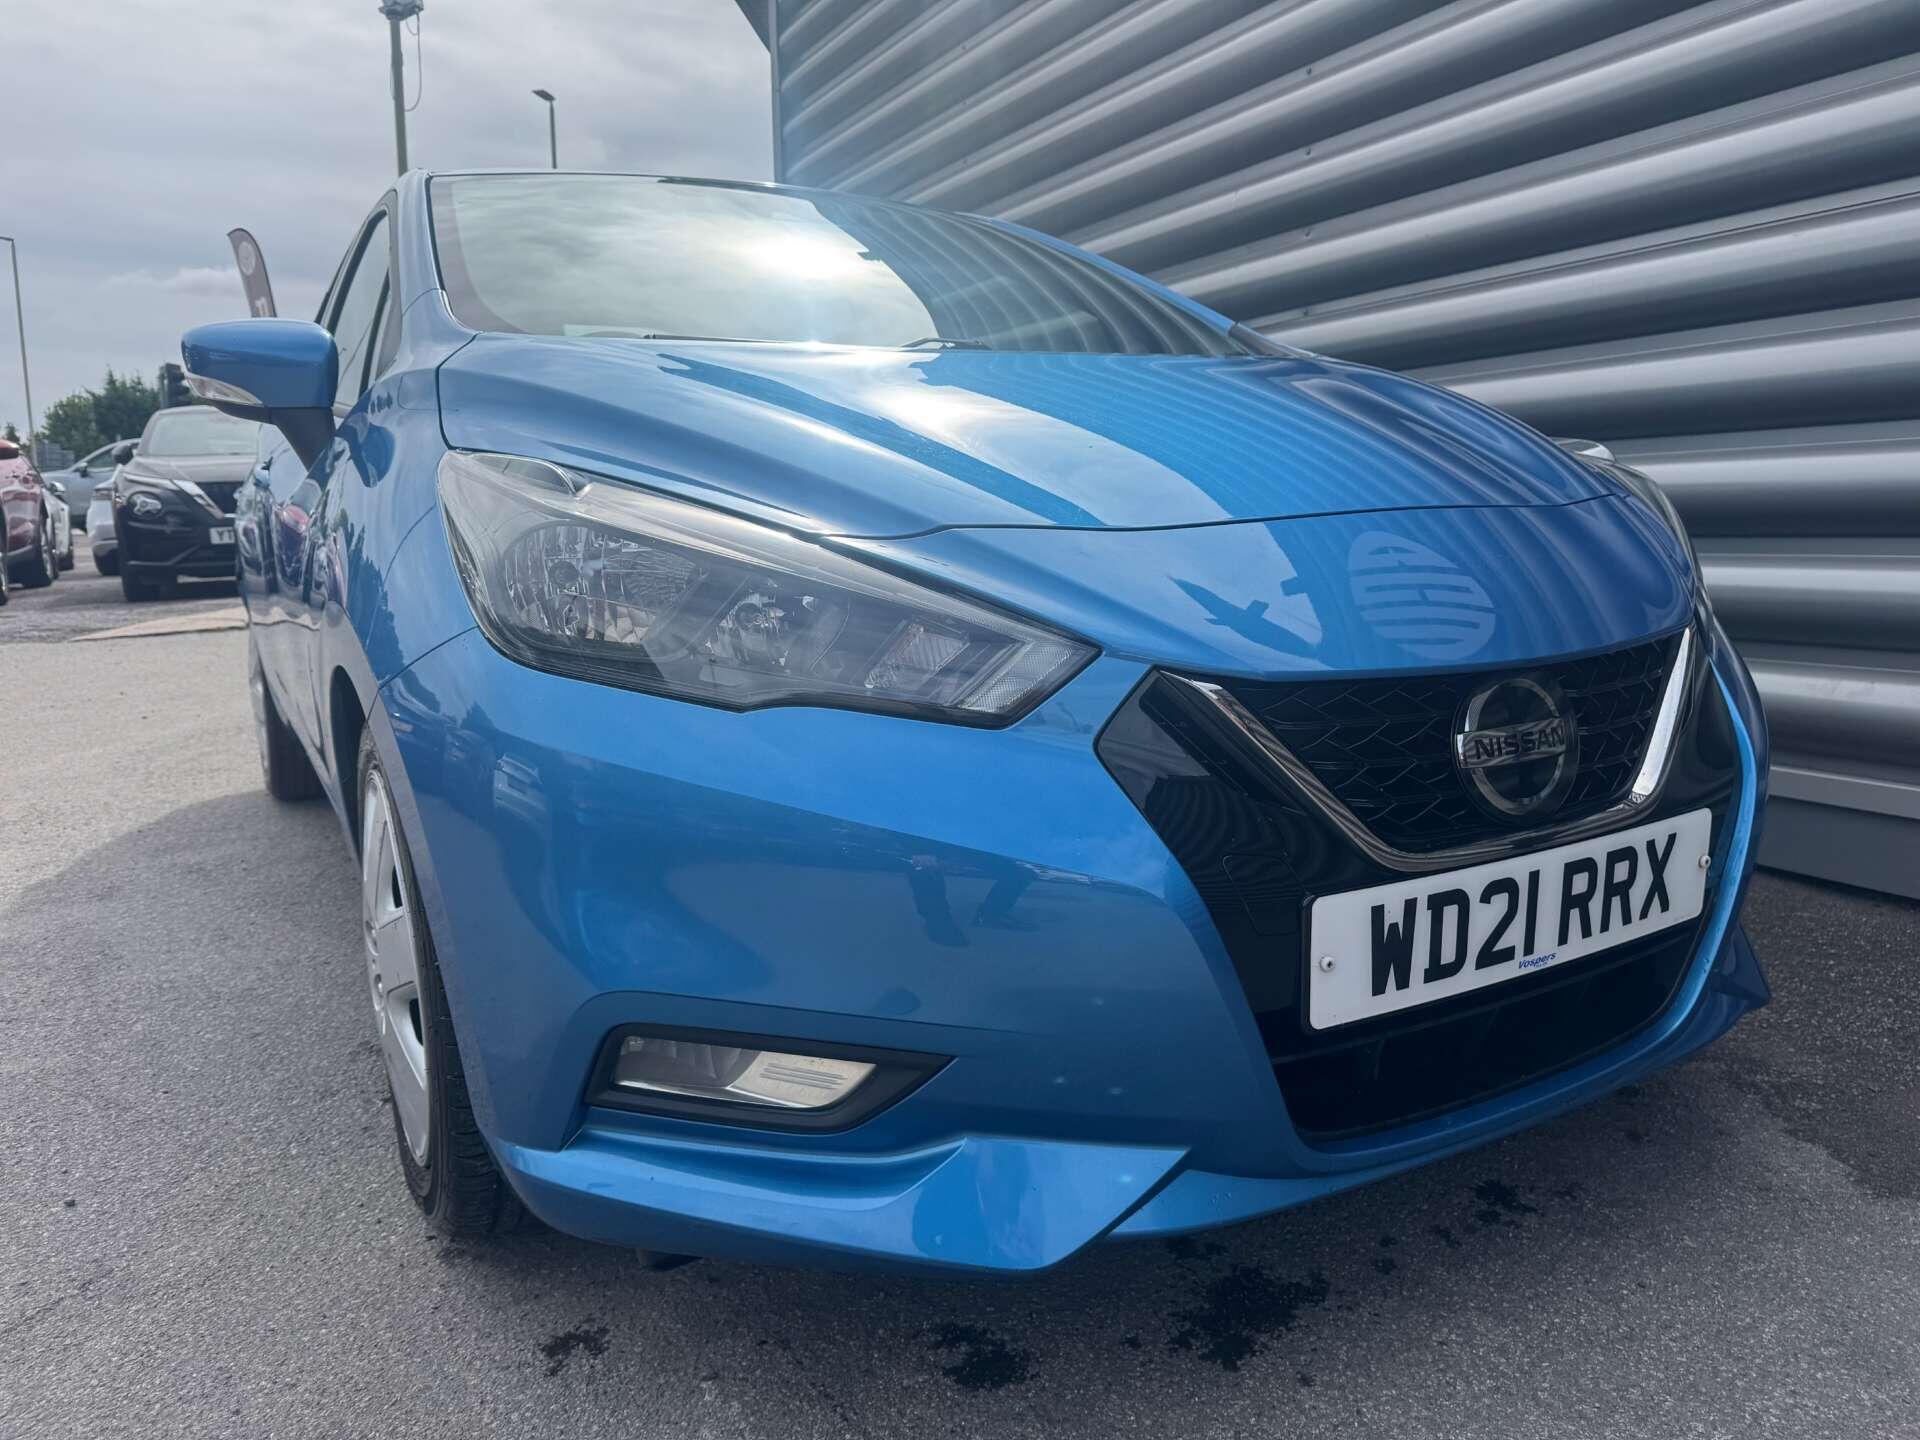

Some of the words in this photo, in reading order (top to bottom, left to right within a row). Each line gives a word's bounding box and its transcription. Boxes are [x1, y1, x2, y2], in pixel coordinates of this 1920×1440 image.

[1474, 725, 1565, 760] NISSAN
[1371, 869, 1540, 997] WD21
[1557, 832, 1677, 947] RRX
[1518, 952, 1557, 969] Vospers
